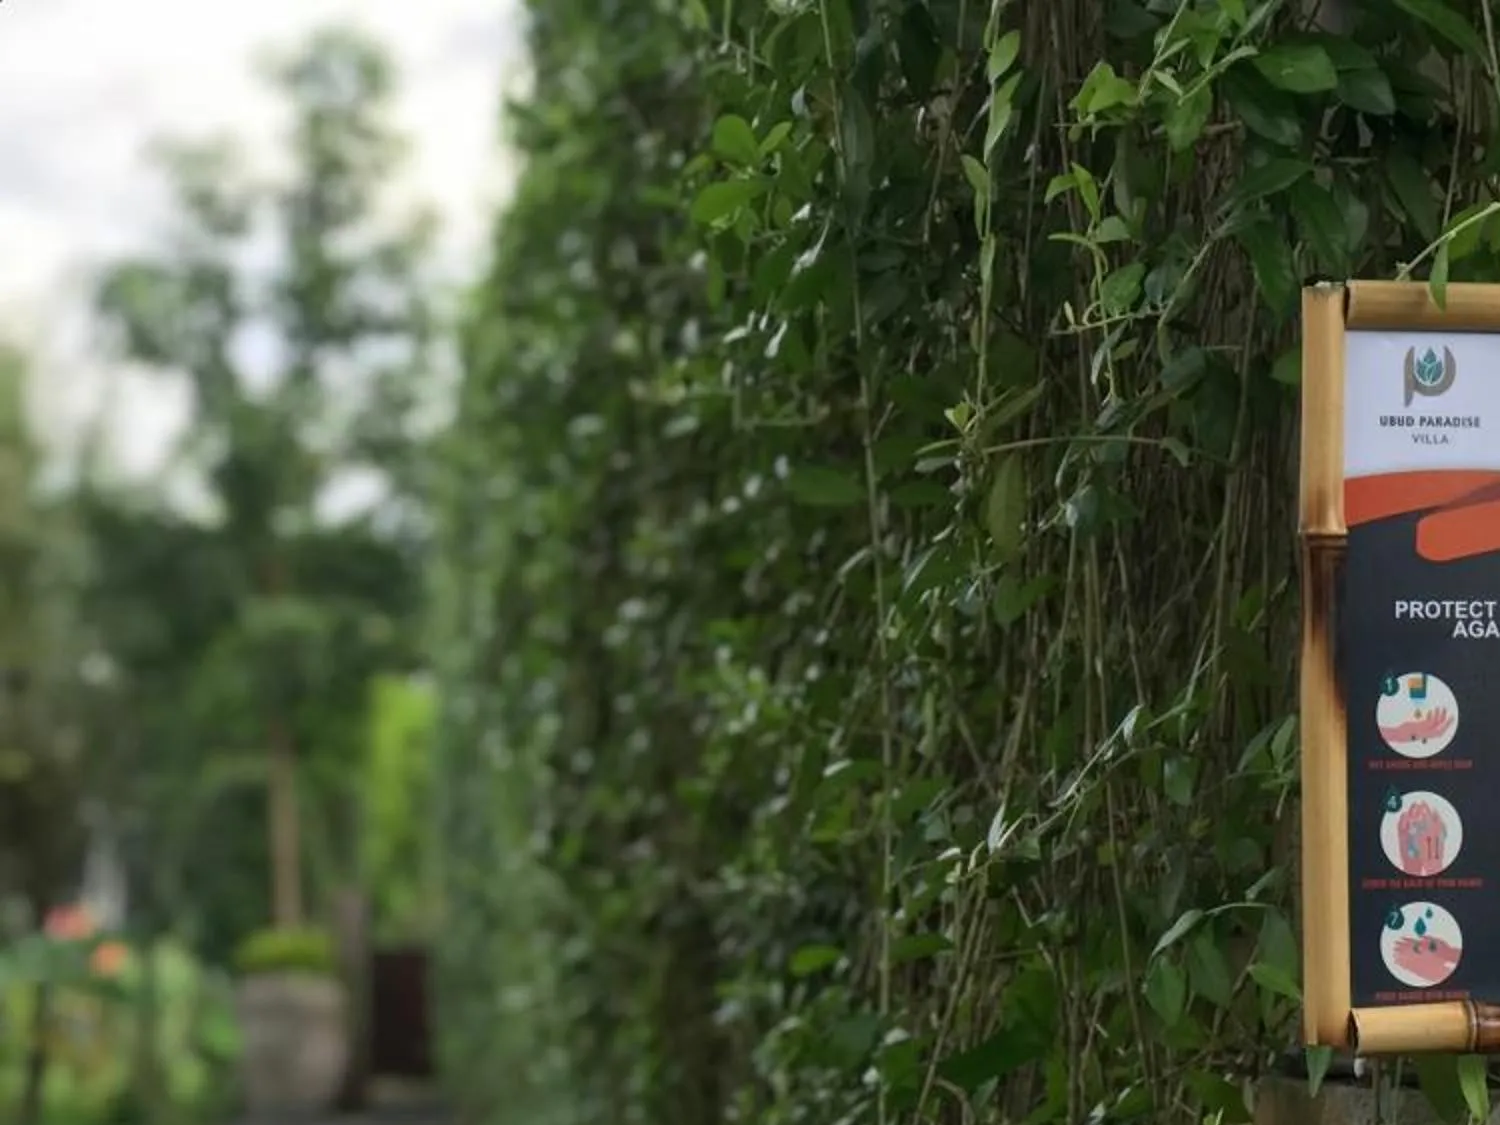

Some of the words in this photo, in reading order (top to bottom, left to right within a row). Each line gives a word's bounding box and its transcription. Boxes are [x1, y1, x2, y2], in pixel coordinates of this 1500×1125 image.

[1379, 415, 1415, 427] UBUD
[1418, 415, 1481, 428] PARADISE
[1411, 433, 1449, 445] VILLA
[1394, 601, 1496, 619] PROTECT
[1385, 677, 1393, 692] 1
[1387, 795, 1397, 808] 4
[1389, 911, 1399, 926] 7
